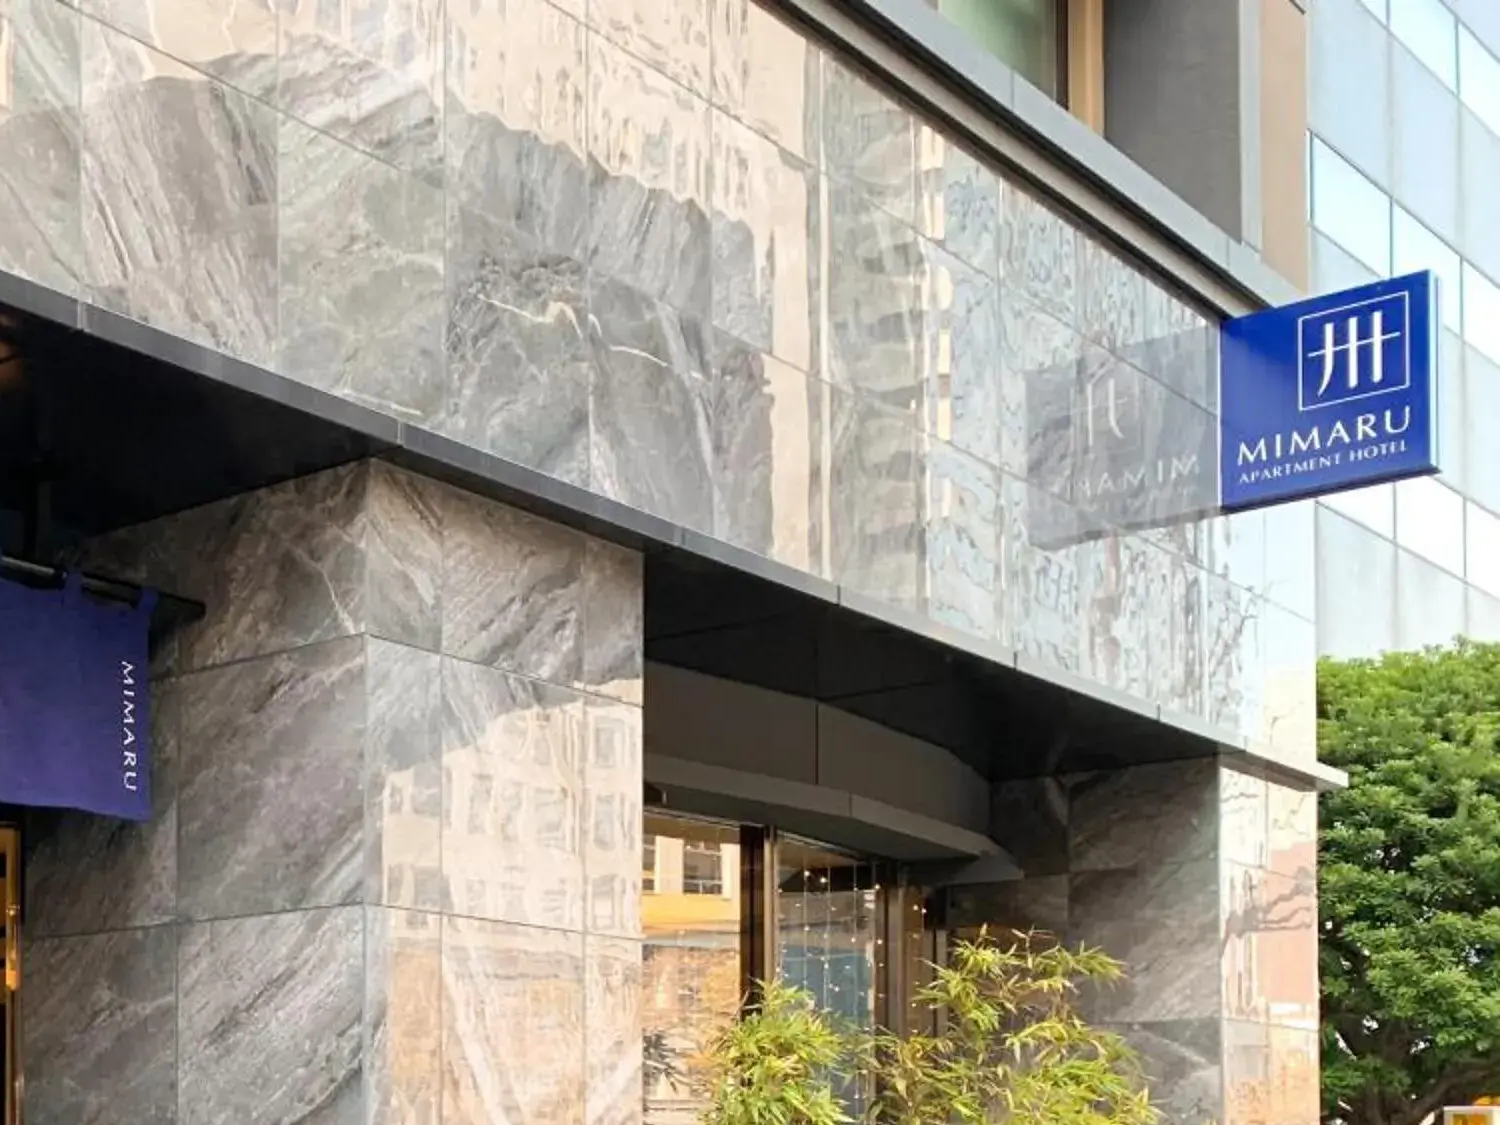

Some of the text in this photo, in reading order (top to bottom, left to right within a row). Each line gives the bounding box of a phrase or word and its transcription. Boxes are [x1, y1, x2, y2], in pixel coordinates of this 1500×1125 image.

[1237, 405, 1410, 466] MIMARU
[1239, 439, 1407, 485] APARTMENT HOTEL
[121, 660, 137, 791] MIMARU
